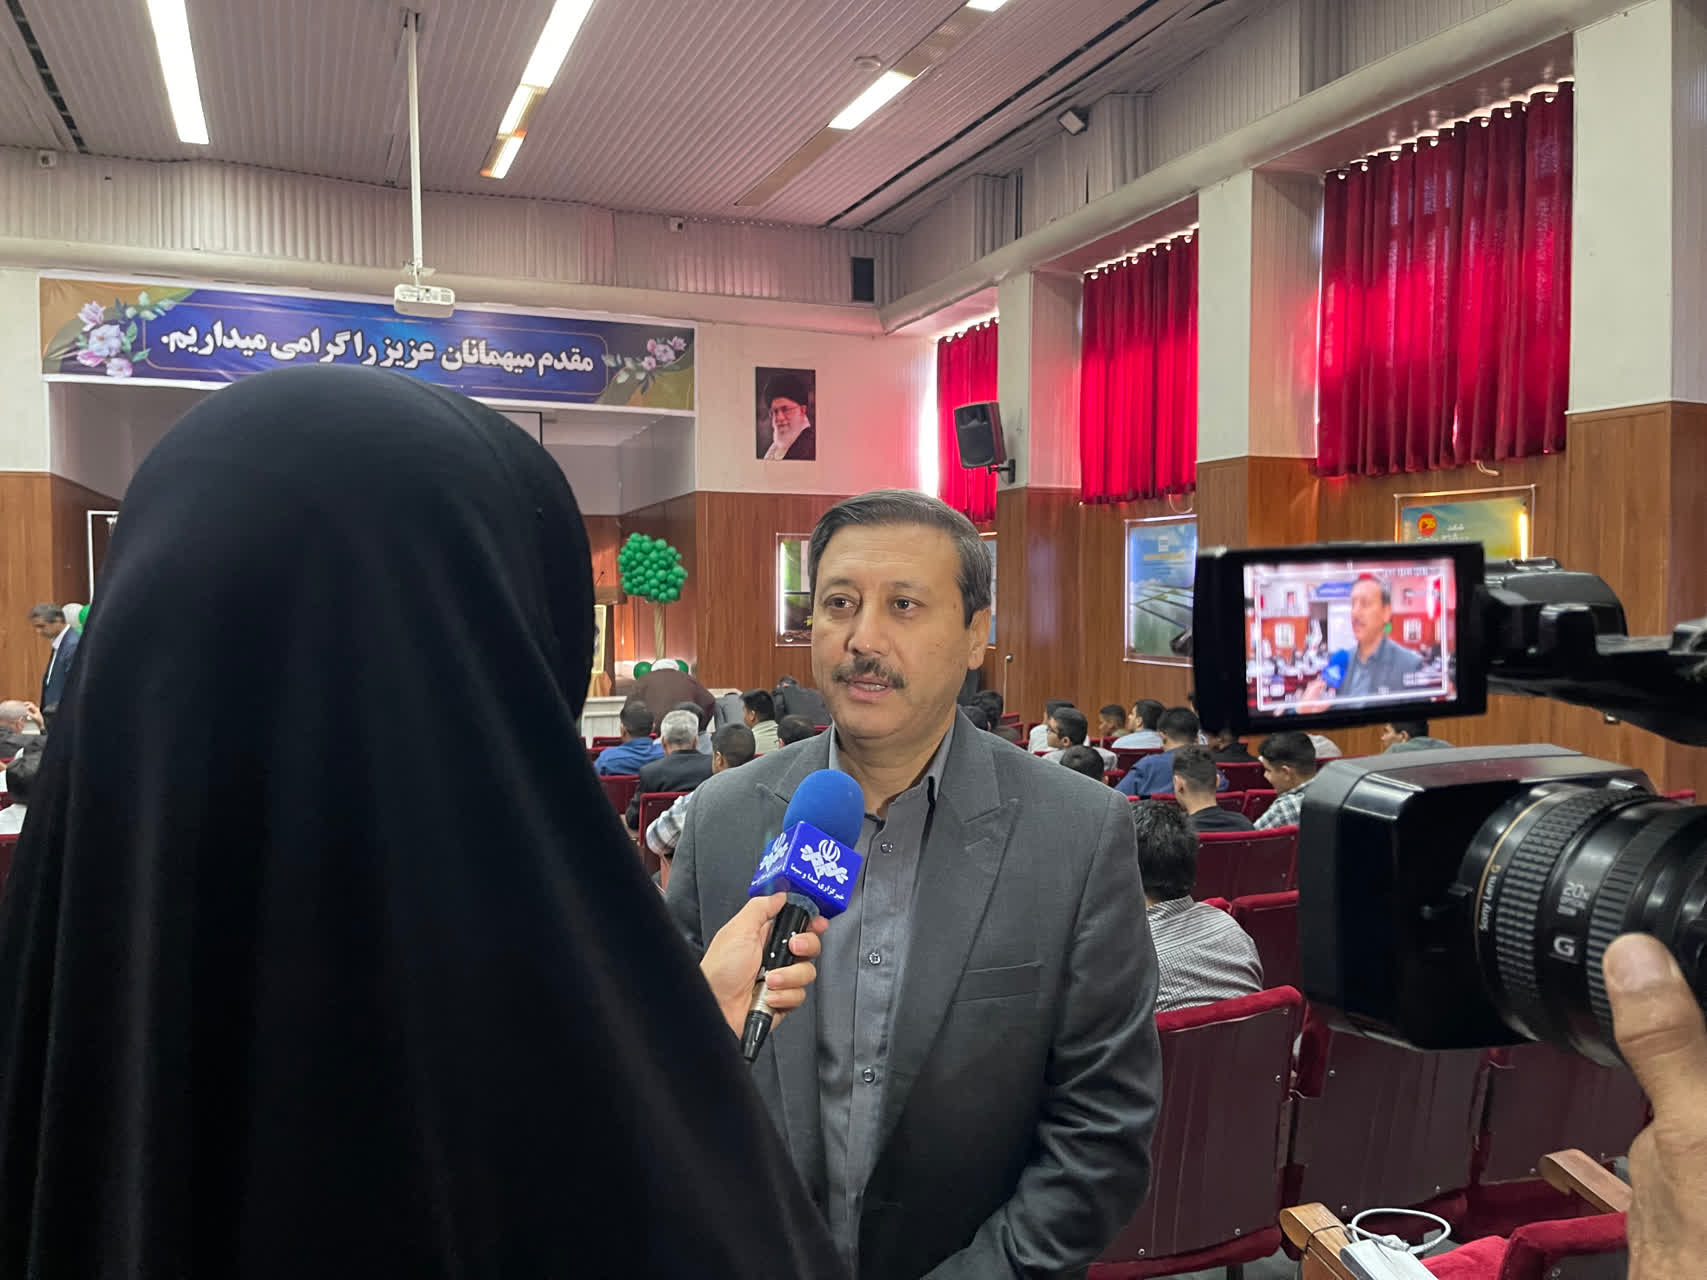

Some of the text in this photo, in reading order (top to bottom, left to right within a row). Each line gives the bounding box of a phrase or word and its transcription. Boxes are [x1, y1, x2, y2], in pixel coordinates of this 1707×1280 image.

[160, 319, 594, 376] مقدم میهمانان عزیز را گرامی میداریم.
[1483, 875, 1497, 901] Lens
[1479, 902, 1493, 931] Sony
[1553, 935, 1576, 958] G
